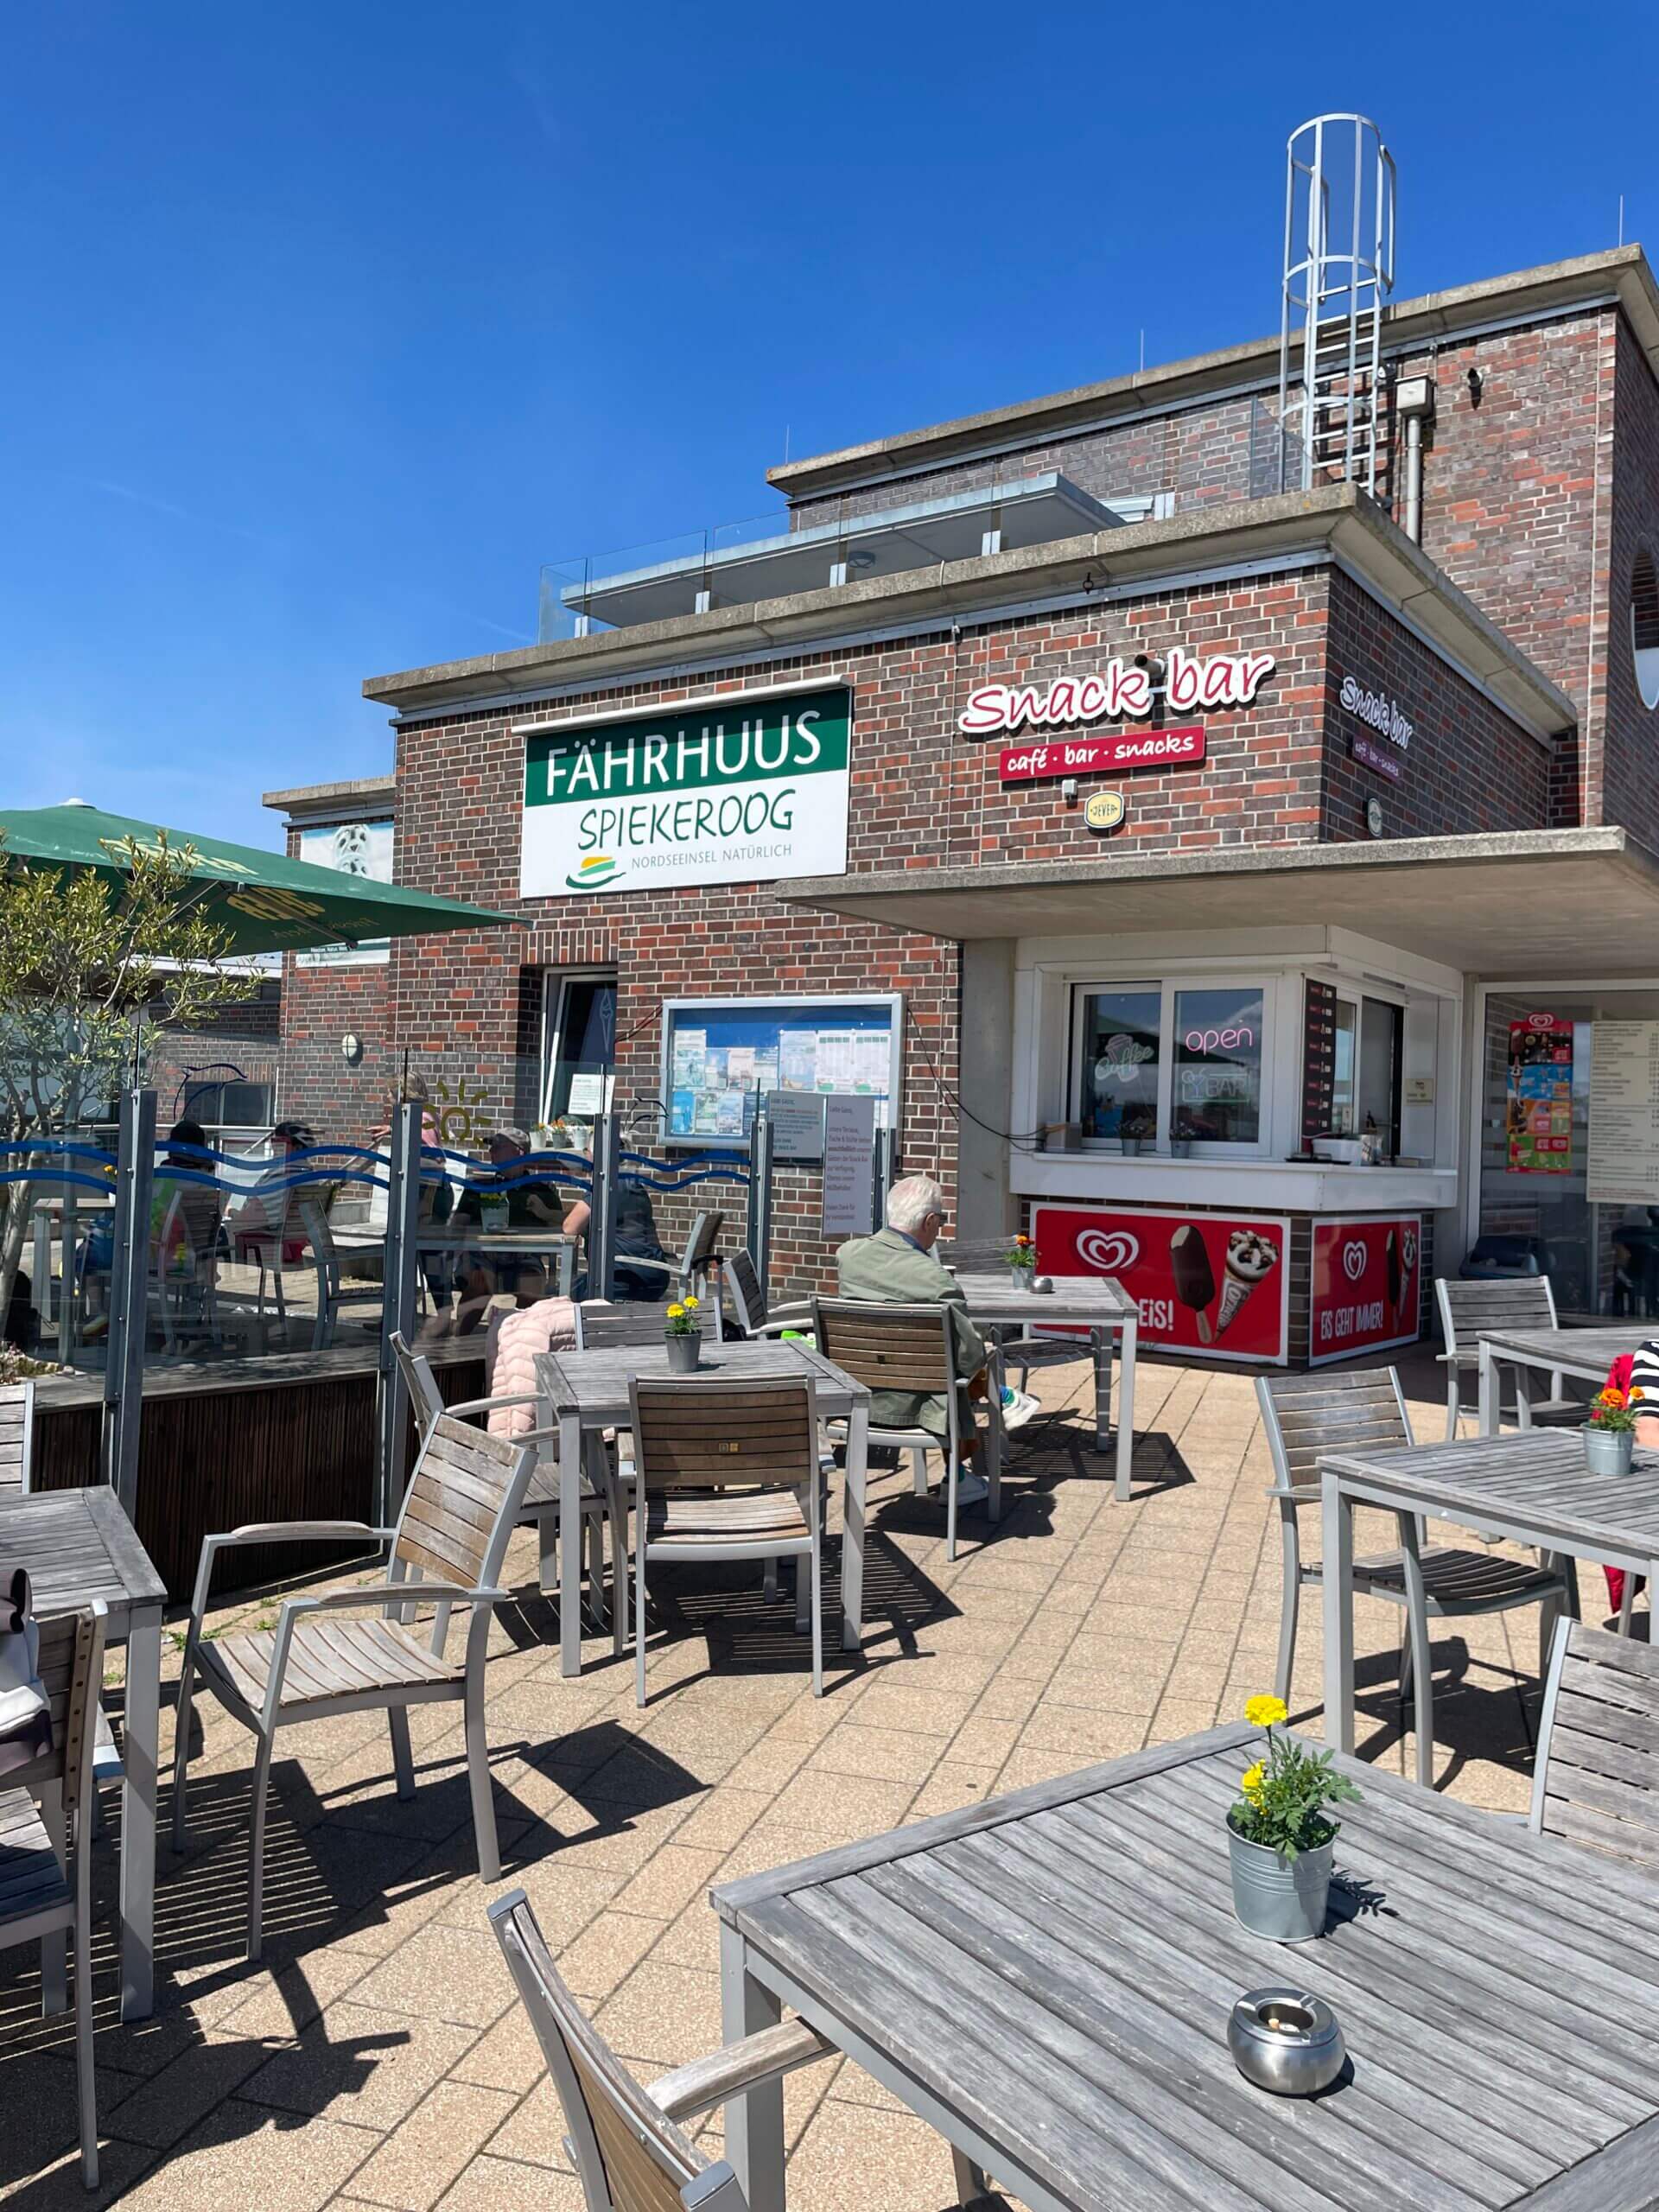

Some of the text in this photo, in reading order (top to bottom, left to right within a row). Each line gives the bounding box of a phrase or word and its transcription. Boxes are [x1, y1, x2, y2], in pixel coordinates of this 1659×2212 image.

[958, 647, 1274, 734] Snack bar
[1340, 676, 1413, 750] Snack bar
[546, 709, 821, 797] FÄHRHUUS
[1007, 734, 1195, 777] café bar snacks
[578, 788, 796, 850] SPIEKEROOG
[1093, 804, 1116, 817] JEVER
[632, 843, 791, 870] NORDSEEINSEL NATÜRLICH
[1185, 1027, 1253, 1056] open
